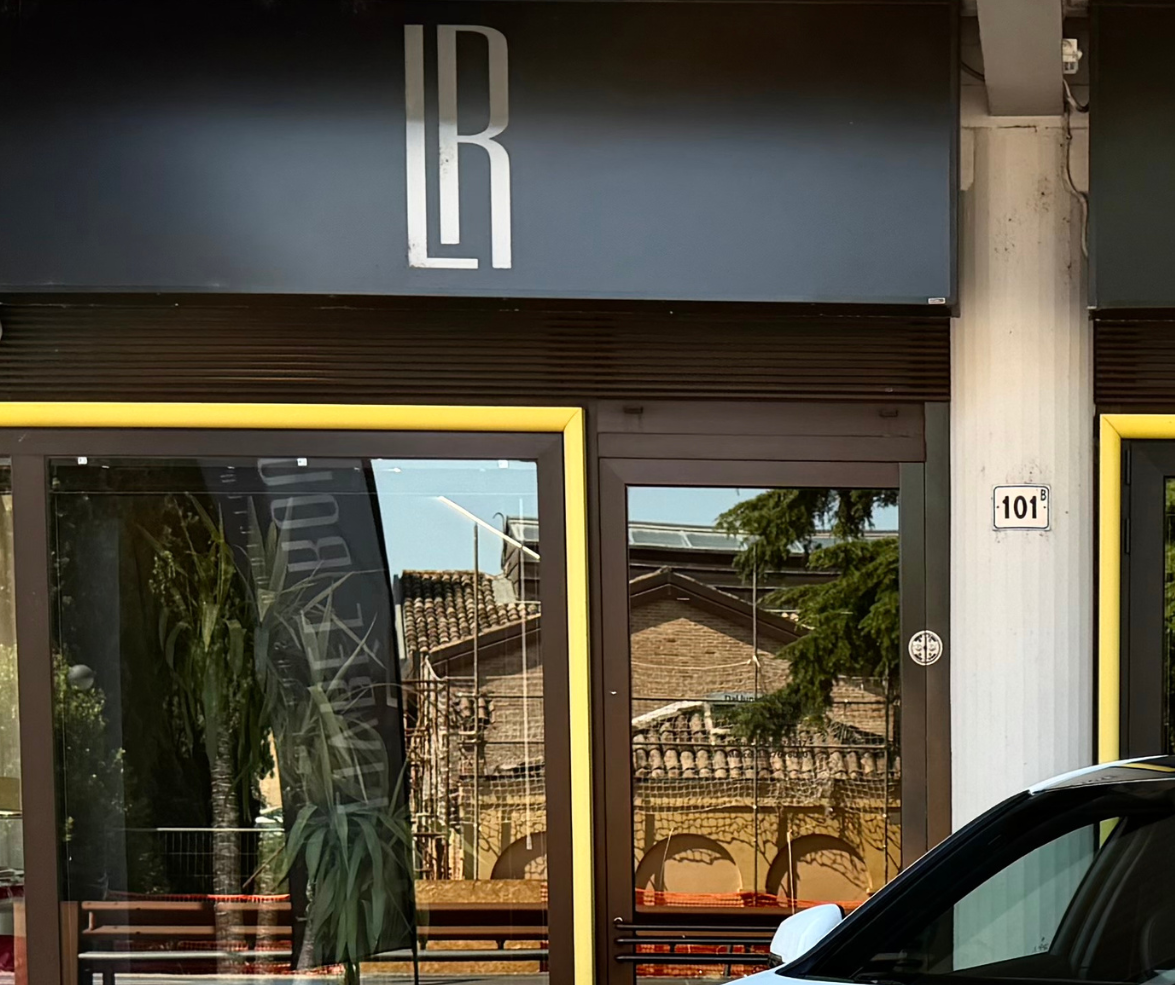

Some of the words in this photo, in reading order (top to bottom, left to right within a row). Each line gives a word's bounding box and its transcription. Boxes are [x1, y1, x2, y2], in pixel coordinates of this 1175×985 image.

[404, 24, 512, 269] LR
[1002, 495, 1037, 519] 101
[1040, 489, 1047, 501] B
